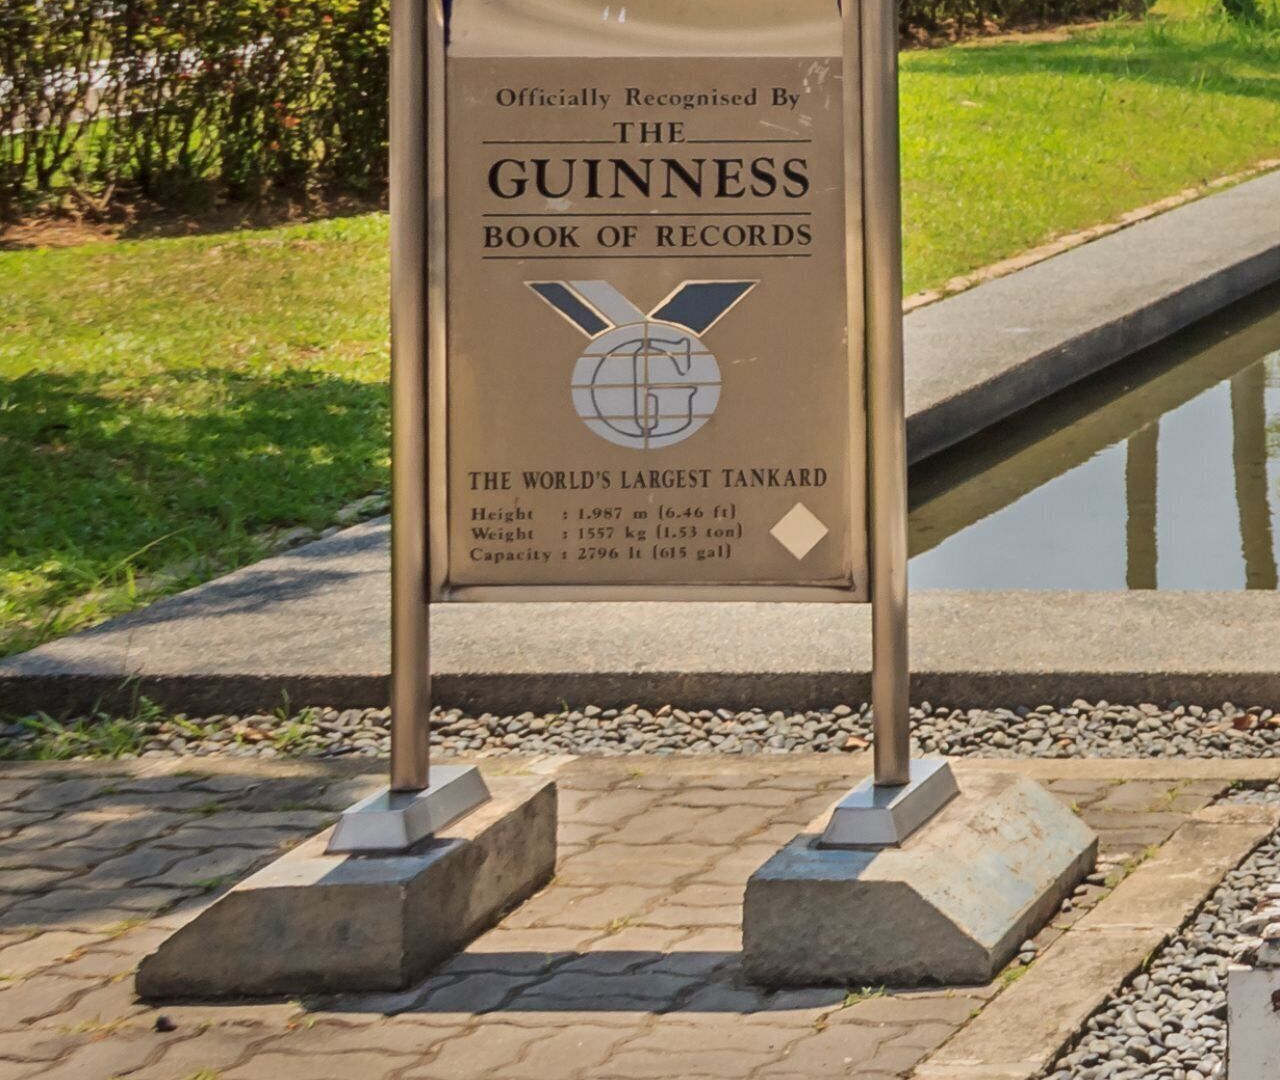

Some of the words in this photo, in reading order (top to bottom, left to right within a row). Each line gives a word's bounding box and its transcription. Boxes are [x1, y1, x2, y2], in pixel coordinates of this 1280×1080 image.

[495, 87, 611, 111] Officially
[625, 87, 757, 110] Recognised
[771, 86, 801, 110] By
[612, 121, 687, 144] THE
[487, 156, 811, 200] GUINNESS
[483, 225, 581, 249] BOOK
[596, 224, 638, 248] OF
[656, 223, 813, 248] RECORDS
[468, 470, 512, 491] THE
[522, 469, 612, 490] WORLD'S
[620, 468, 713, 489] LARGEST
[721, 467, 829, 488] TANKARD
[471, 506, 534, 522] Height
[577, 506, 623, 521] 1.987
[632, 509, 649, 520] m
[471, 526, 534, 542] Weight
[577, 526, 615, 540] 1557
[624, 525, 648, 542] kg
[469, 547, 551, 564] Capacity
[577, 546, 619, 560] 2796
[696, 542, 733, 561] gal)
